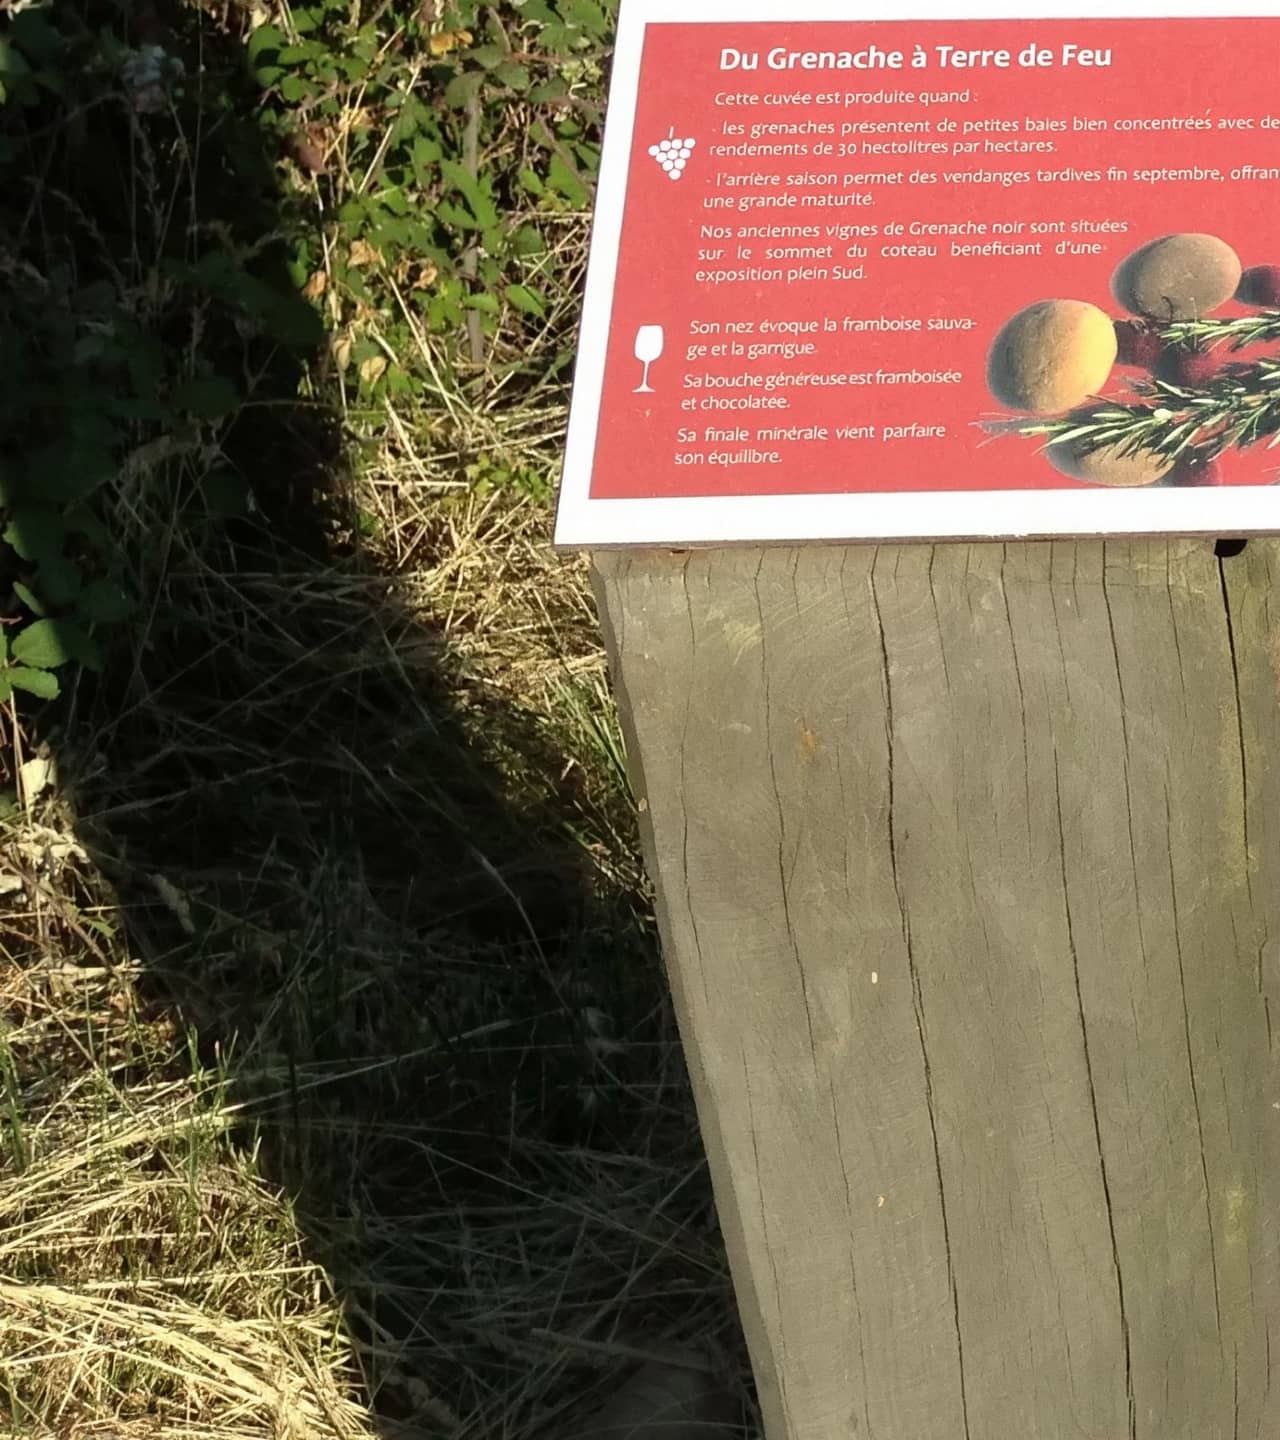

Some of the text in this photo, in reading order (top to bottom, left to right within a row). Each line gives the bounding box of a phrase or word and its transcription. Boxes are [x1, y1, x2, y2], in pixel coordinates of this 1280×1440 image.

[719, 42, 1113, 71] Du Grenache à Terre de Feu
[714, 90, 760, 106] Cette
[763, 89, 812, 106] cuvée
[815, 91, 841, 105] est
[844, 88, 916, 109] produite
[918, 88, 970, 109] quand
[722, 120, 746, 136] les
[750, 119, 835, 140] grenaches
[936, 117, 957, 133] de
[963, 115, 1019, 137] petites
[1024, 115, 1067, 132] baies
[1072, 115, 1108, 131] bien
[1216, 116, 1255, 131] avec
[709, 137, 1058, 159] rendements de 30 hectolitres par hectares.
[785, 170, 838, 187] saison
[842, 170, 905, 190] permet
[908, 168, 939, 185] des
[943, 166, 1030, 190] vendanges
[1036, 166, 1102, 183] tardives
[1106, 165, 1128, 182] fin
[1132, 164, 1225, 186] septembre,
[703, 190, 876, 213] une grande maturité.
[700, 217, 1129, 241] Nos anciennes vignes de Grenache noir sont situées
[697, 246, 725, 261] sur
[737, 245, 753, 260] le
[764, 244, 834, 261] sommet
[846, 242, 869, 260] du
[880, 243, 938, 259] coteau
[694, 262, 868, 286] exposition plein Sud.
[689, 315, 978, 338] Son nez évoque la framboise sauva-
[686, 341, 708, 362] ge
[711, 341, 727, 357] et
[730, 339, 746, 357] la
[683, 367, 963, 392] Sa bouche généreuse est framboisée
[681, 396, 697, 411] et
[676, 421, 947, 445] Sa finale minérale vient parfaire
[674, 447, 783, 468] son équilibre.
